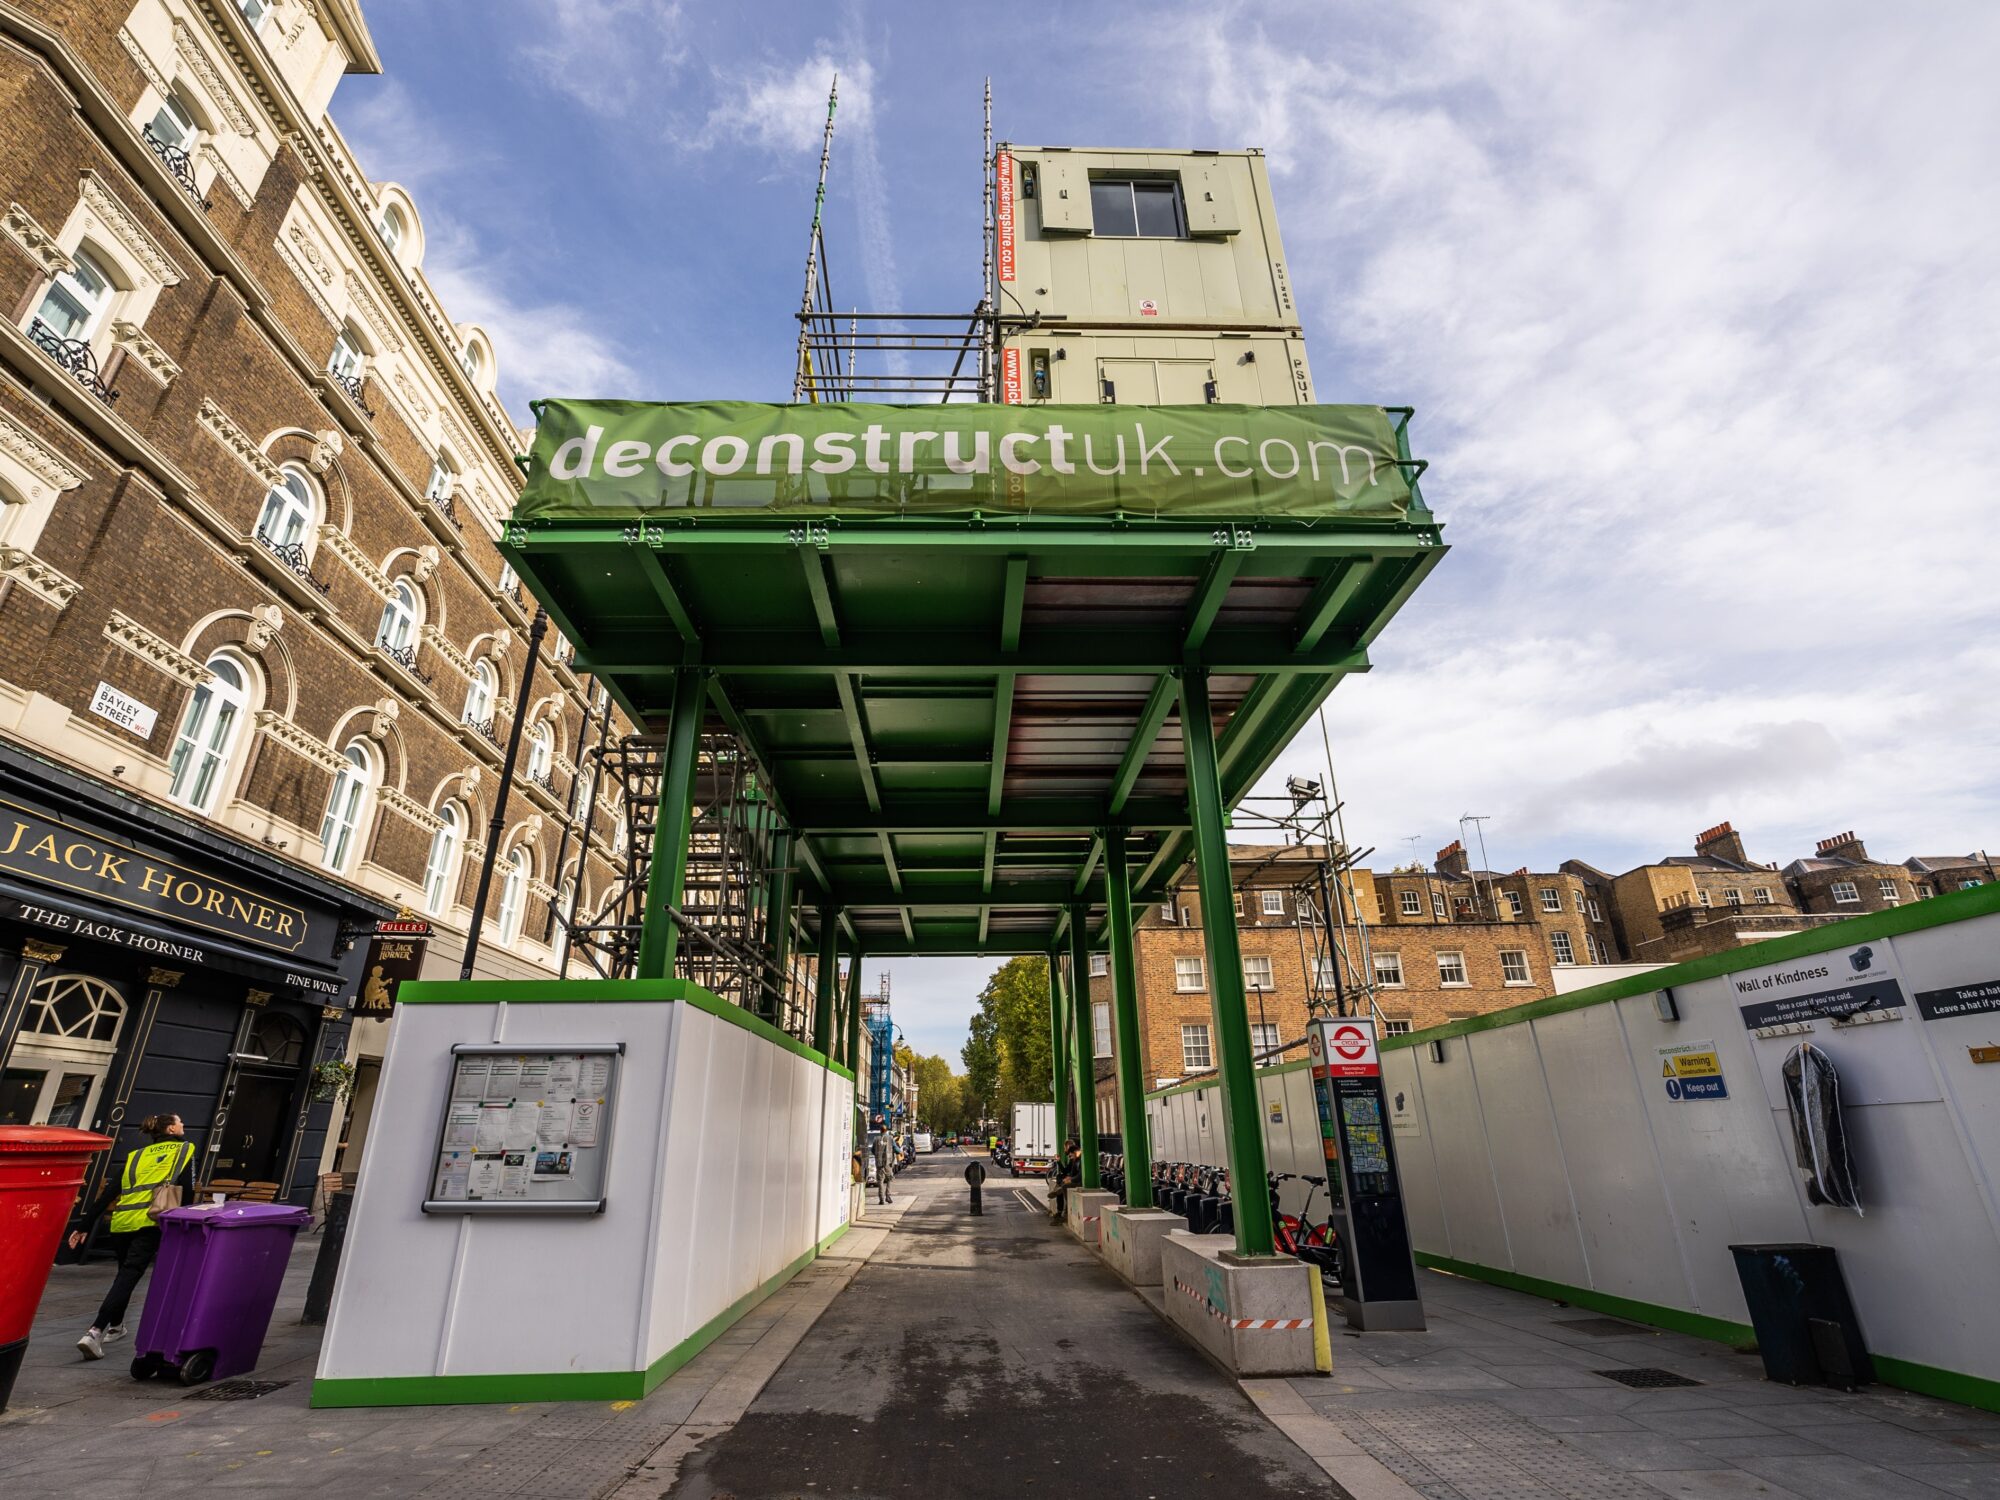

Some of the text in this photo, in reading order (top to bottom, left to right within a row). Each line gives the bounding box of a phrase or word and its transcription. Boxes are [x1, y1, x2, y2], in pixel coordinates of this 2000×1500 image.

[999, 153, 1013, 280] www.pickeringshire.co.uk
[549, 424, 1381, 486] deconstructuk.com
[96, 702, 134, 726] STREET
[101, 691, 140, 717] BAYLEY
[1, 821, 294, 938] JACK HORNER
[19, 904, 204, 963] THE JACK HORNER
[379, 950, 411, 961] HORNER
[381, 942, 414, 954] THE JACK
[285, 973, 339, 995] FINE WINE
[1736, 966, 1829, 993] Wall of Kindness
[1775, 1003, 1790, 1011] Take
[1796, 1000, 1809, 1008] coat
[1808, 998, 1814, 1006] if
[1814, 995, 1836, 1006] you're
[1837, 992, 1854, 1001] cold.
[1956, 990, 1978, 999] Take
[1985, 986, 2000, 995] hat
[1760, 1015, 1778, 1024] Leave
[1782, 1011, 1795, 1021] coat
[1795, 1010, 1800, 1018] if
[1801, 1008, 1813, 1018] you
[1831, 1004, 1843, 1012] use
[1843, 1002, 1850, 1010] it
[1933, 1004, 1959, 1014] Leave
[1966, 1001, 1982, 1009] hat
[1982, 999, 1989, 1007] if
[1679, 1056, 1711, 1067] Warning
[1686, 1082, 1719, 1093] Keep out
